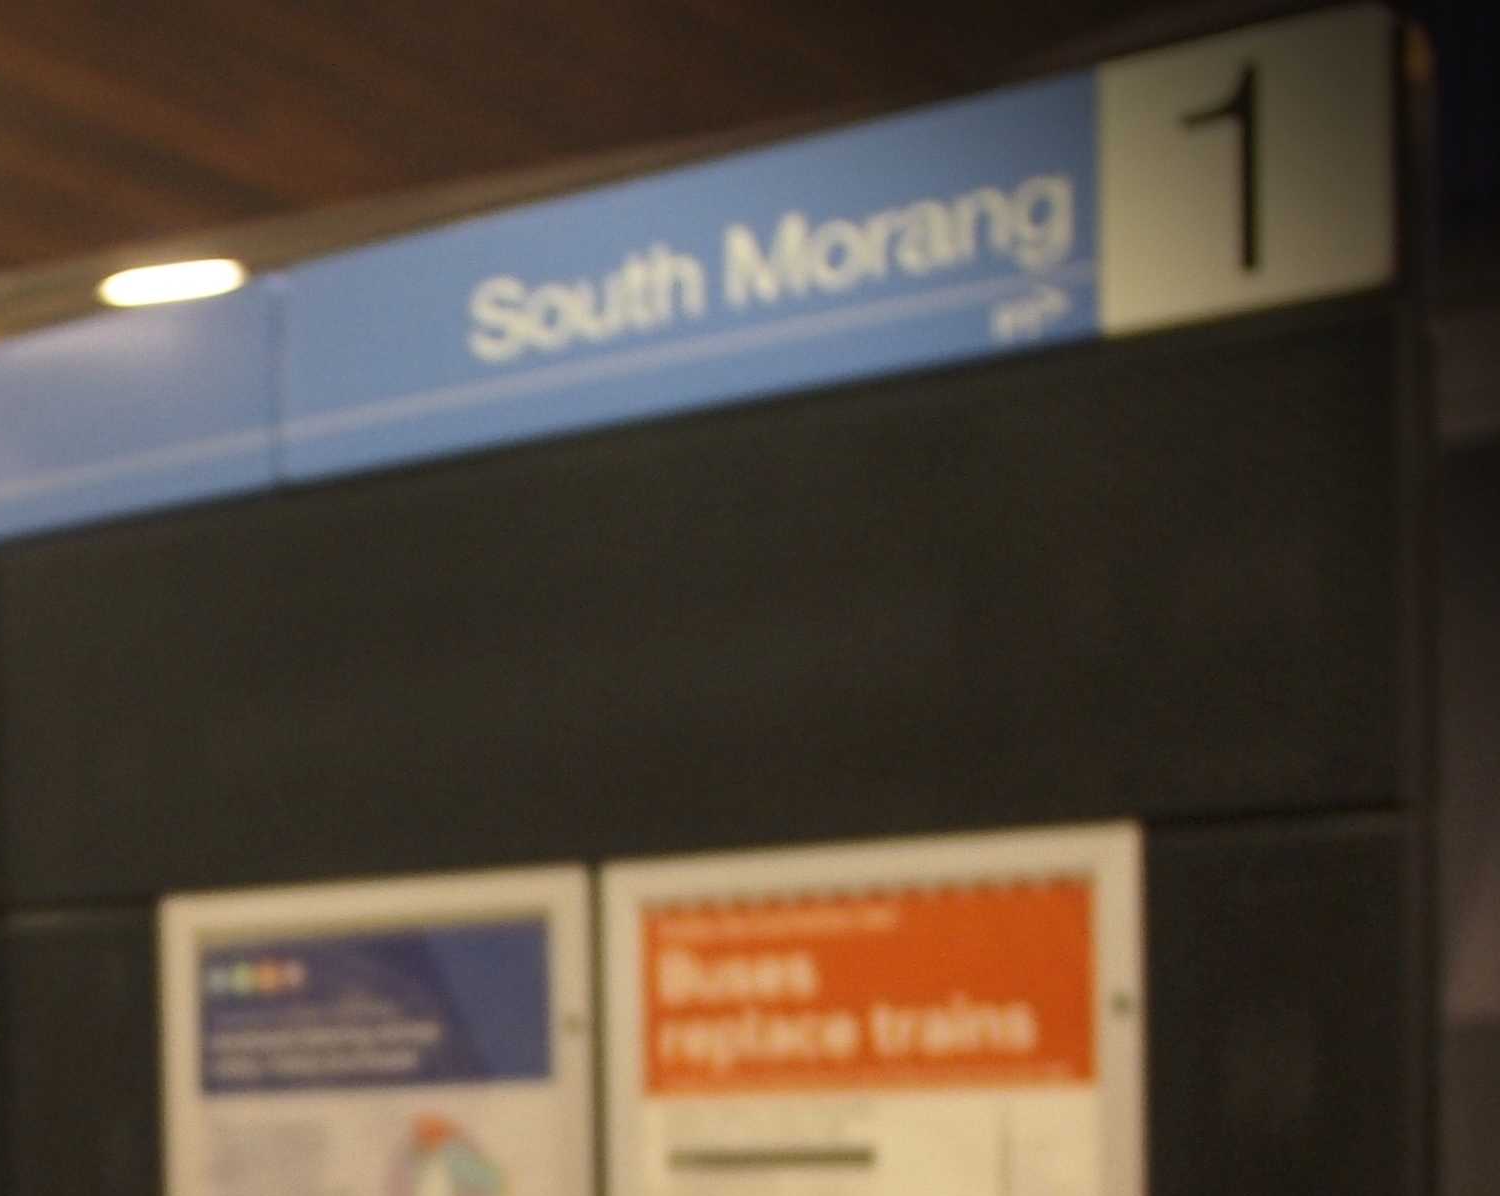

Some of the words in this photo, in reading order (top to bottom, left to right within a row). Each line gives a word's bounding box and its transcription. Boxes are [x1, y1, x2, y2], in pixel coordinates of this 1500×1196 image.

[1180, 60, 1262, 274] 1
[468, 242, 706, 364] South
[723, 173, 1074, 306] Morang
[656, 946, 817, 1004] Buses
[657, 1008, 859, 1071] replace
[870, 994, 1036, 1057] trains
